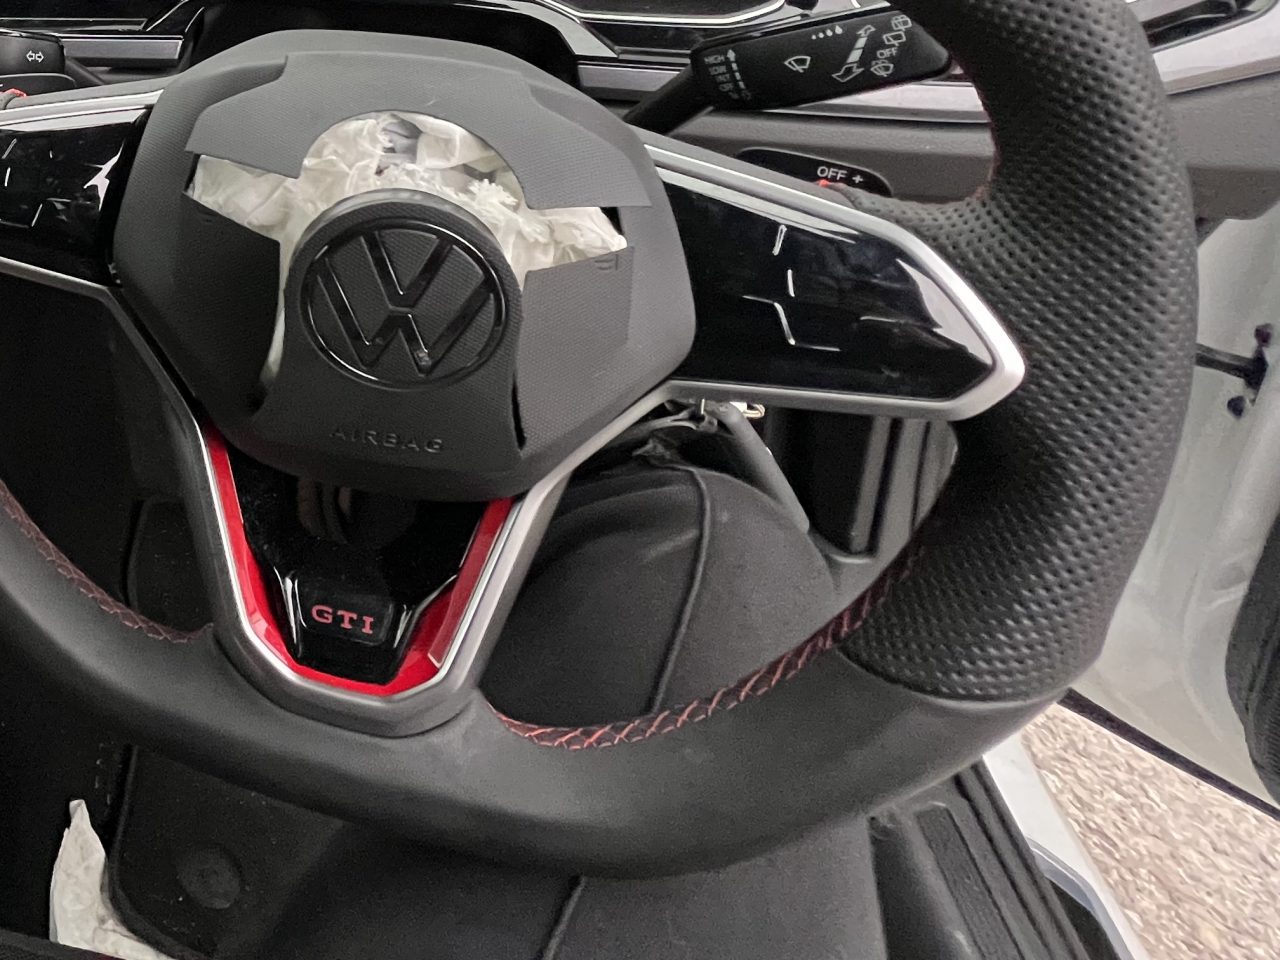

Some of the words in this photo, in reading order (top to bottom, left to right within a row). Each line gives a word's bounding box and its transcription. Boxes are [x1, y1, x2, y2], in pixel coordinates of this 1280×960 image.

[876, 47, 897, 59] OFF
[817, 166, 847, 180] OFF
[329, 430, 443, 453] AIRBAG
[311, 604, 374, 634] GTI
